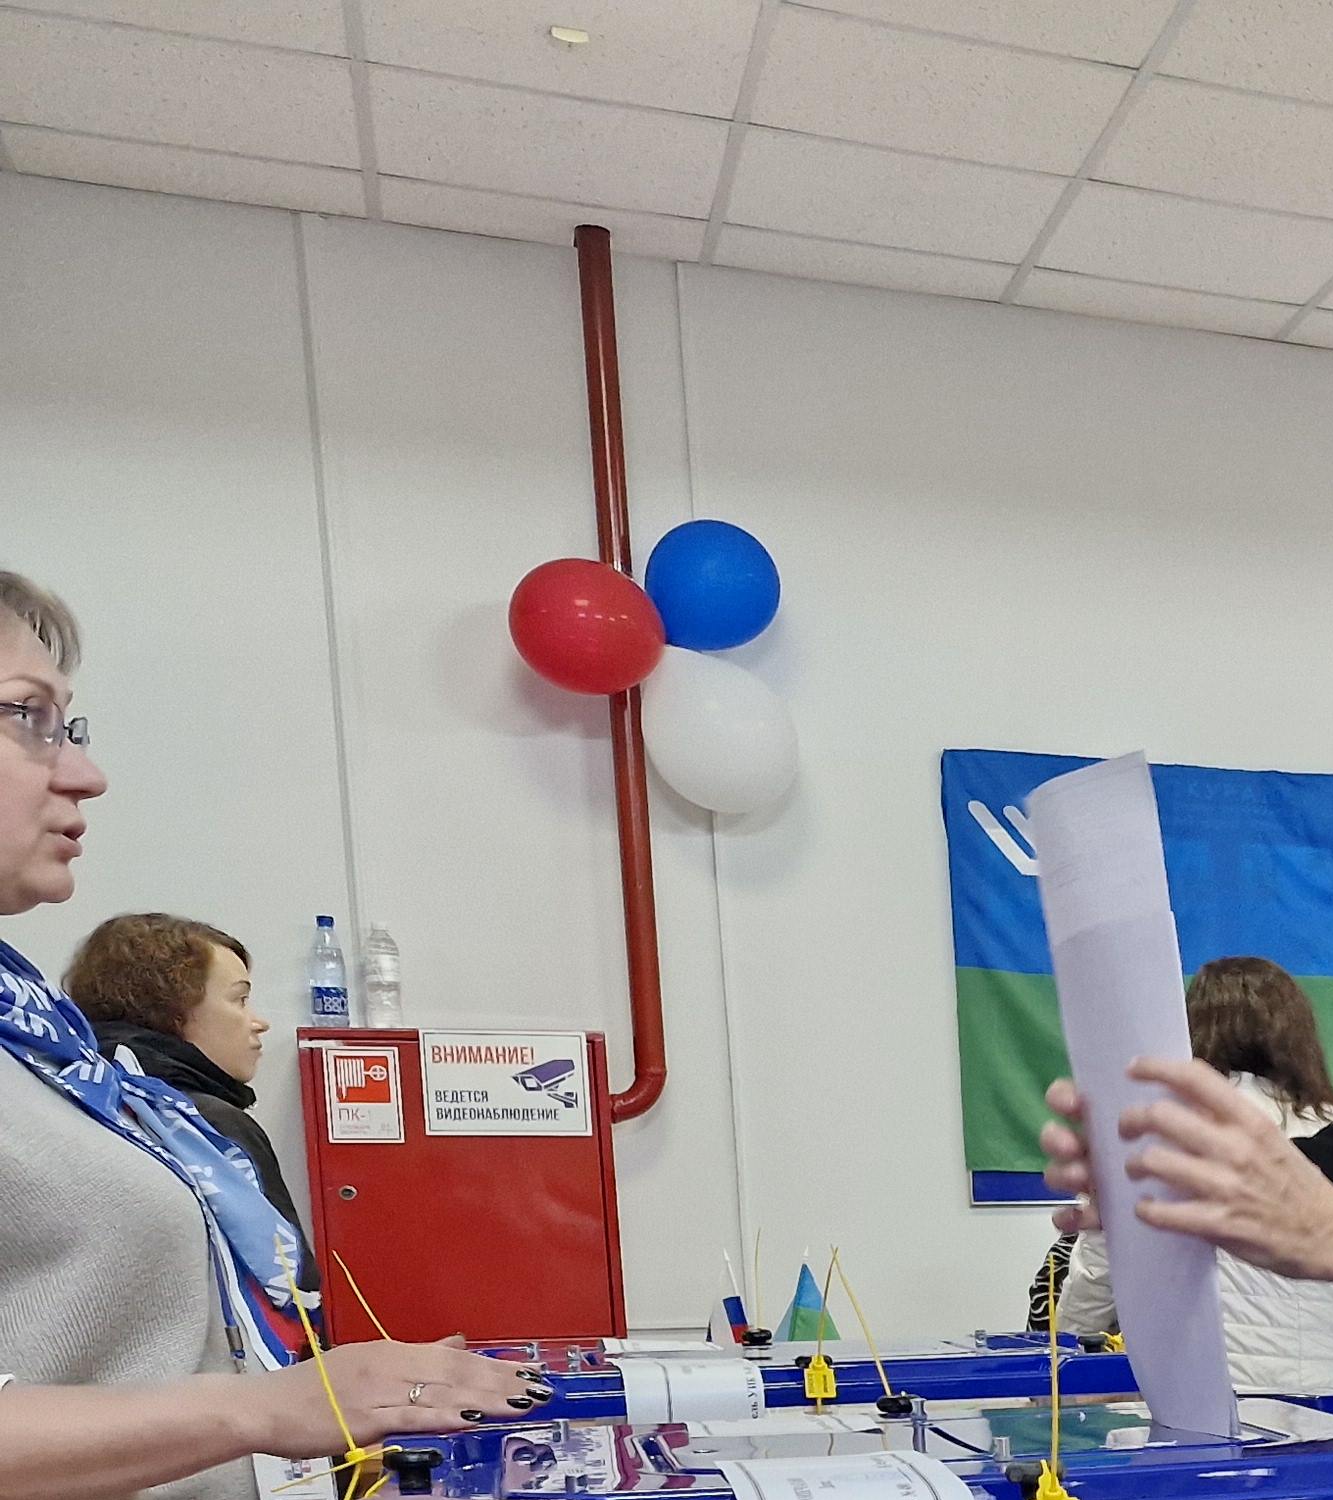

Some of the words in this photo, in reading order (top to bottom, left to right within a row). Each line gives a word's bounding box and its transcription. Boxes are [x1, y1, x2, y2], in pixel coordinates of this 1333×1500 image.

[431, 1045, 535, 1065] ВНИМАНИЕ!
[435, 1090, 489, 1104] ВЕДЕТСЯ
[436, 1107, 560, 1122] ВИДЕОНАБЛЮДЕНИЕ
